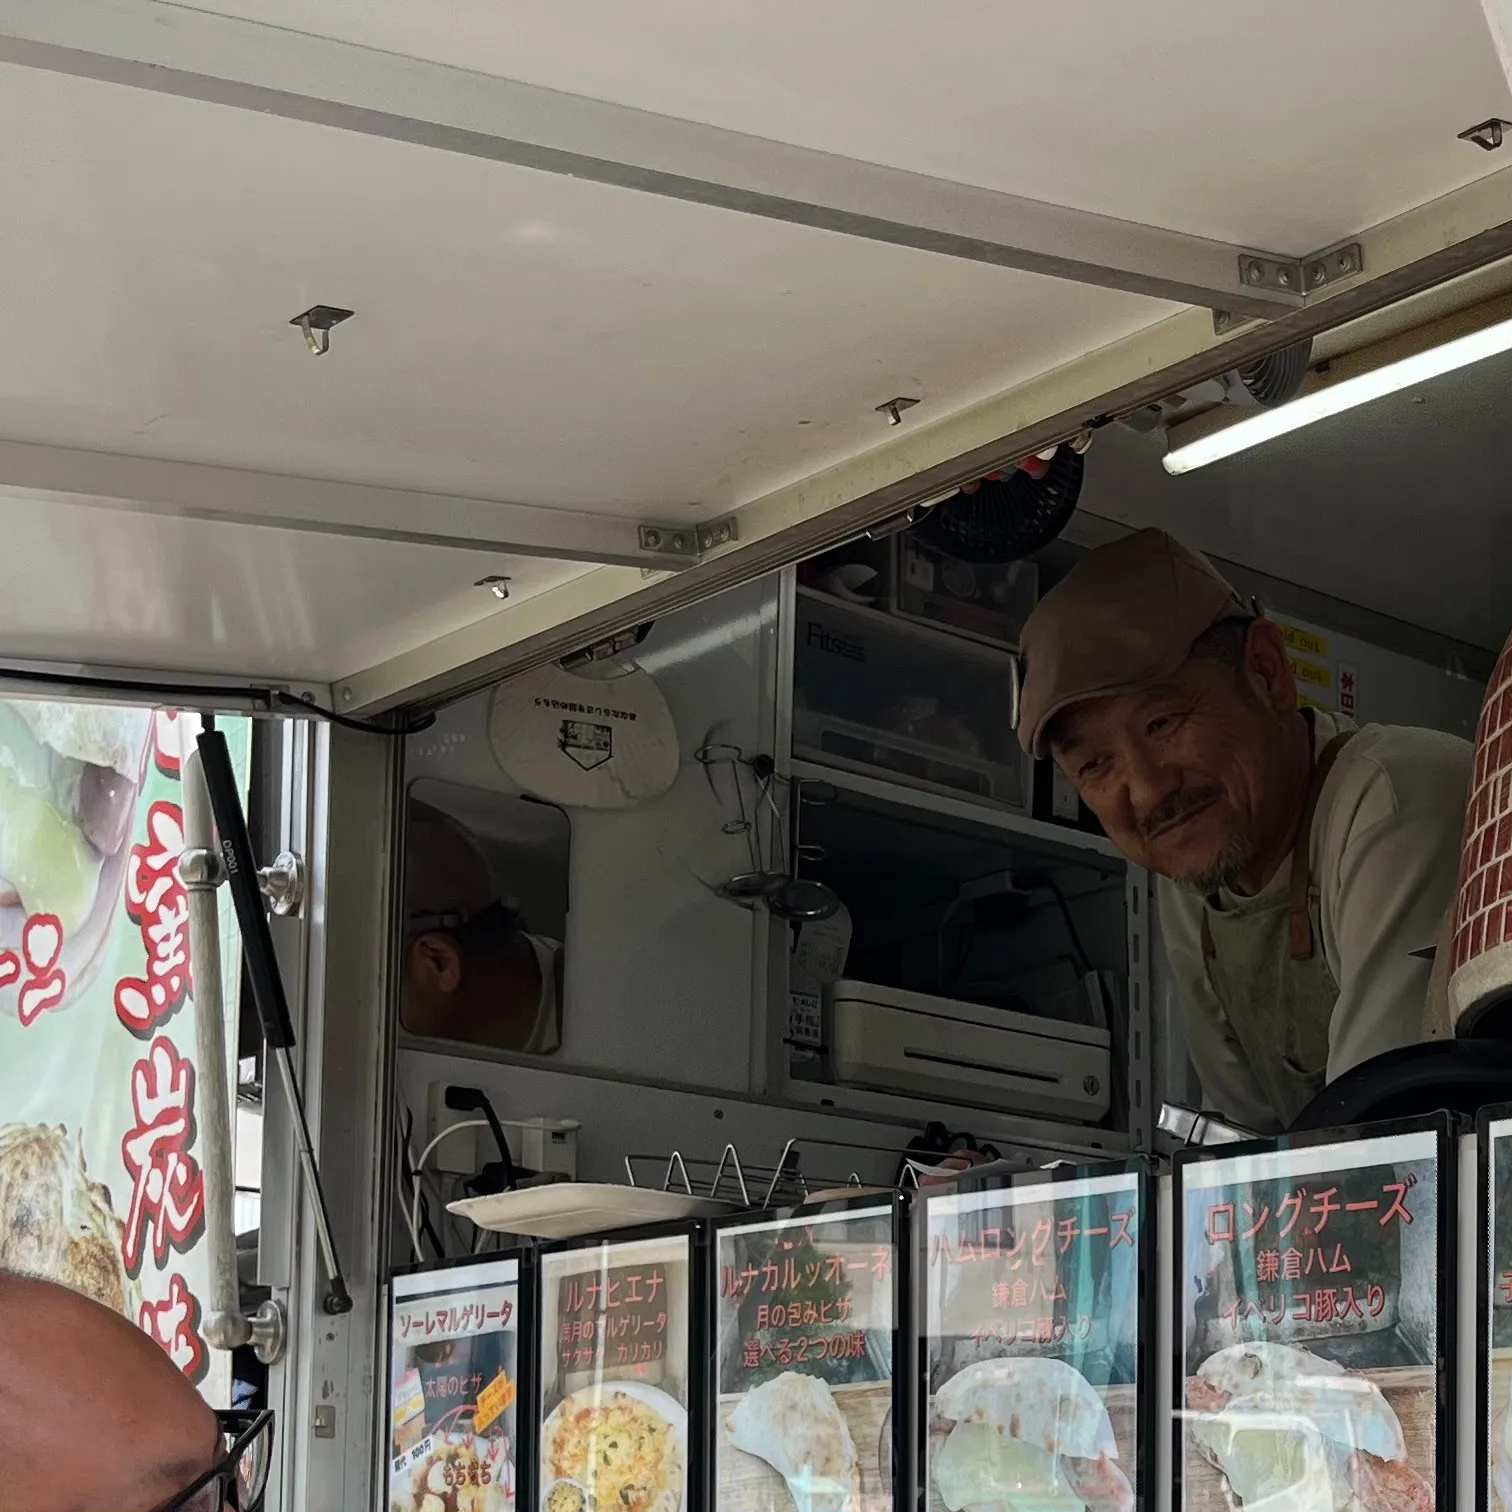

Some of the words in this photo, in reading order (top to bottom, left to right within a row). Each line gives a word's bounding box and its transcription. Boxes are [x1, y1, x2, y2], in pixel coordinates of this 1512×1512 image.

[1208, 1173, 1418, 1245] ロングチーズ
[1257, 1243, 1352, 1283] 鎌倉ハム
[400, 1300, 513, 1338] ソーレマルゲリータ
[1224, 1284, 1385, 1329] イベリコ豚入り
